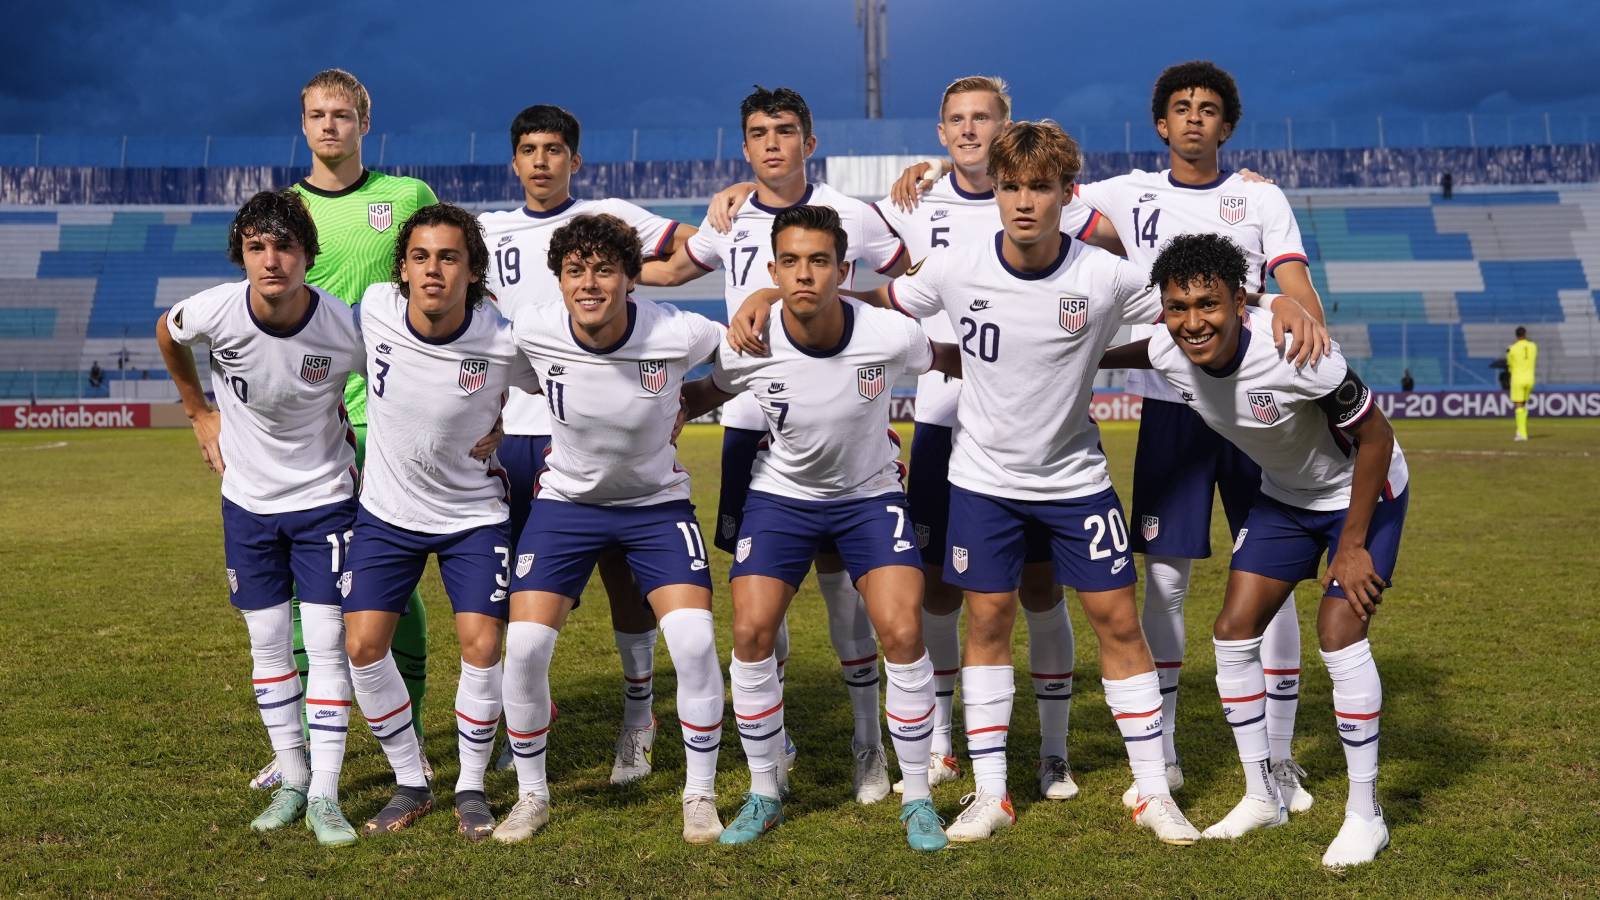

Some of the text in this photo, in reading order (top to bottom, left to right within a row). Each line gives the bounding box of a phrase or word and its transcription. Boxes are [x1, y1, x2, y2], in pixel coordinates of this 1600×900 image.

[371, 205, 389, 214] USA
[1223, 198, 1244, 209] USA
[1133, 207, 1160, 248] 14
[495, 247, 520, 288] 19
[730, 246, 759, 286] 17
[1063, 301, 1086, 314] USA
[960, 317, 1000, 363] 20
[306, 357, 328, 369] USA
[464, 361, 485, 375] USA
[642, 361, 663, 374] USA
[860, 369, 882, 381] USA
[224, 369, 248, 404] 0
[373, 358, 391, 398] 3
[546, 380, 566, 421] 11
[1251, 395, 1272, 408] USA
[1340, 386, 1367, 421] Concacaf
[1378, 394, 1437, 418] U-20
[15, 405, 134, 428] Scotiabank
[771, 402, 789, 432] 7
[886, 505, 905, 538] 7
[1083, 508, 1128, 560] 20
[1143, 517, 1158, 527] USA
[676, 522, 705, 560] 11
[953, 548, 967, 559] USA
[494, 546, 511, 588] 3
[518, 555, 533, 565] USA
